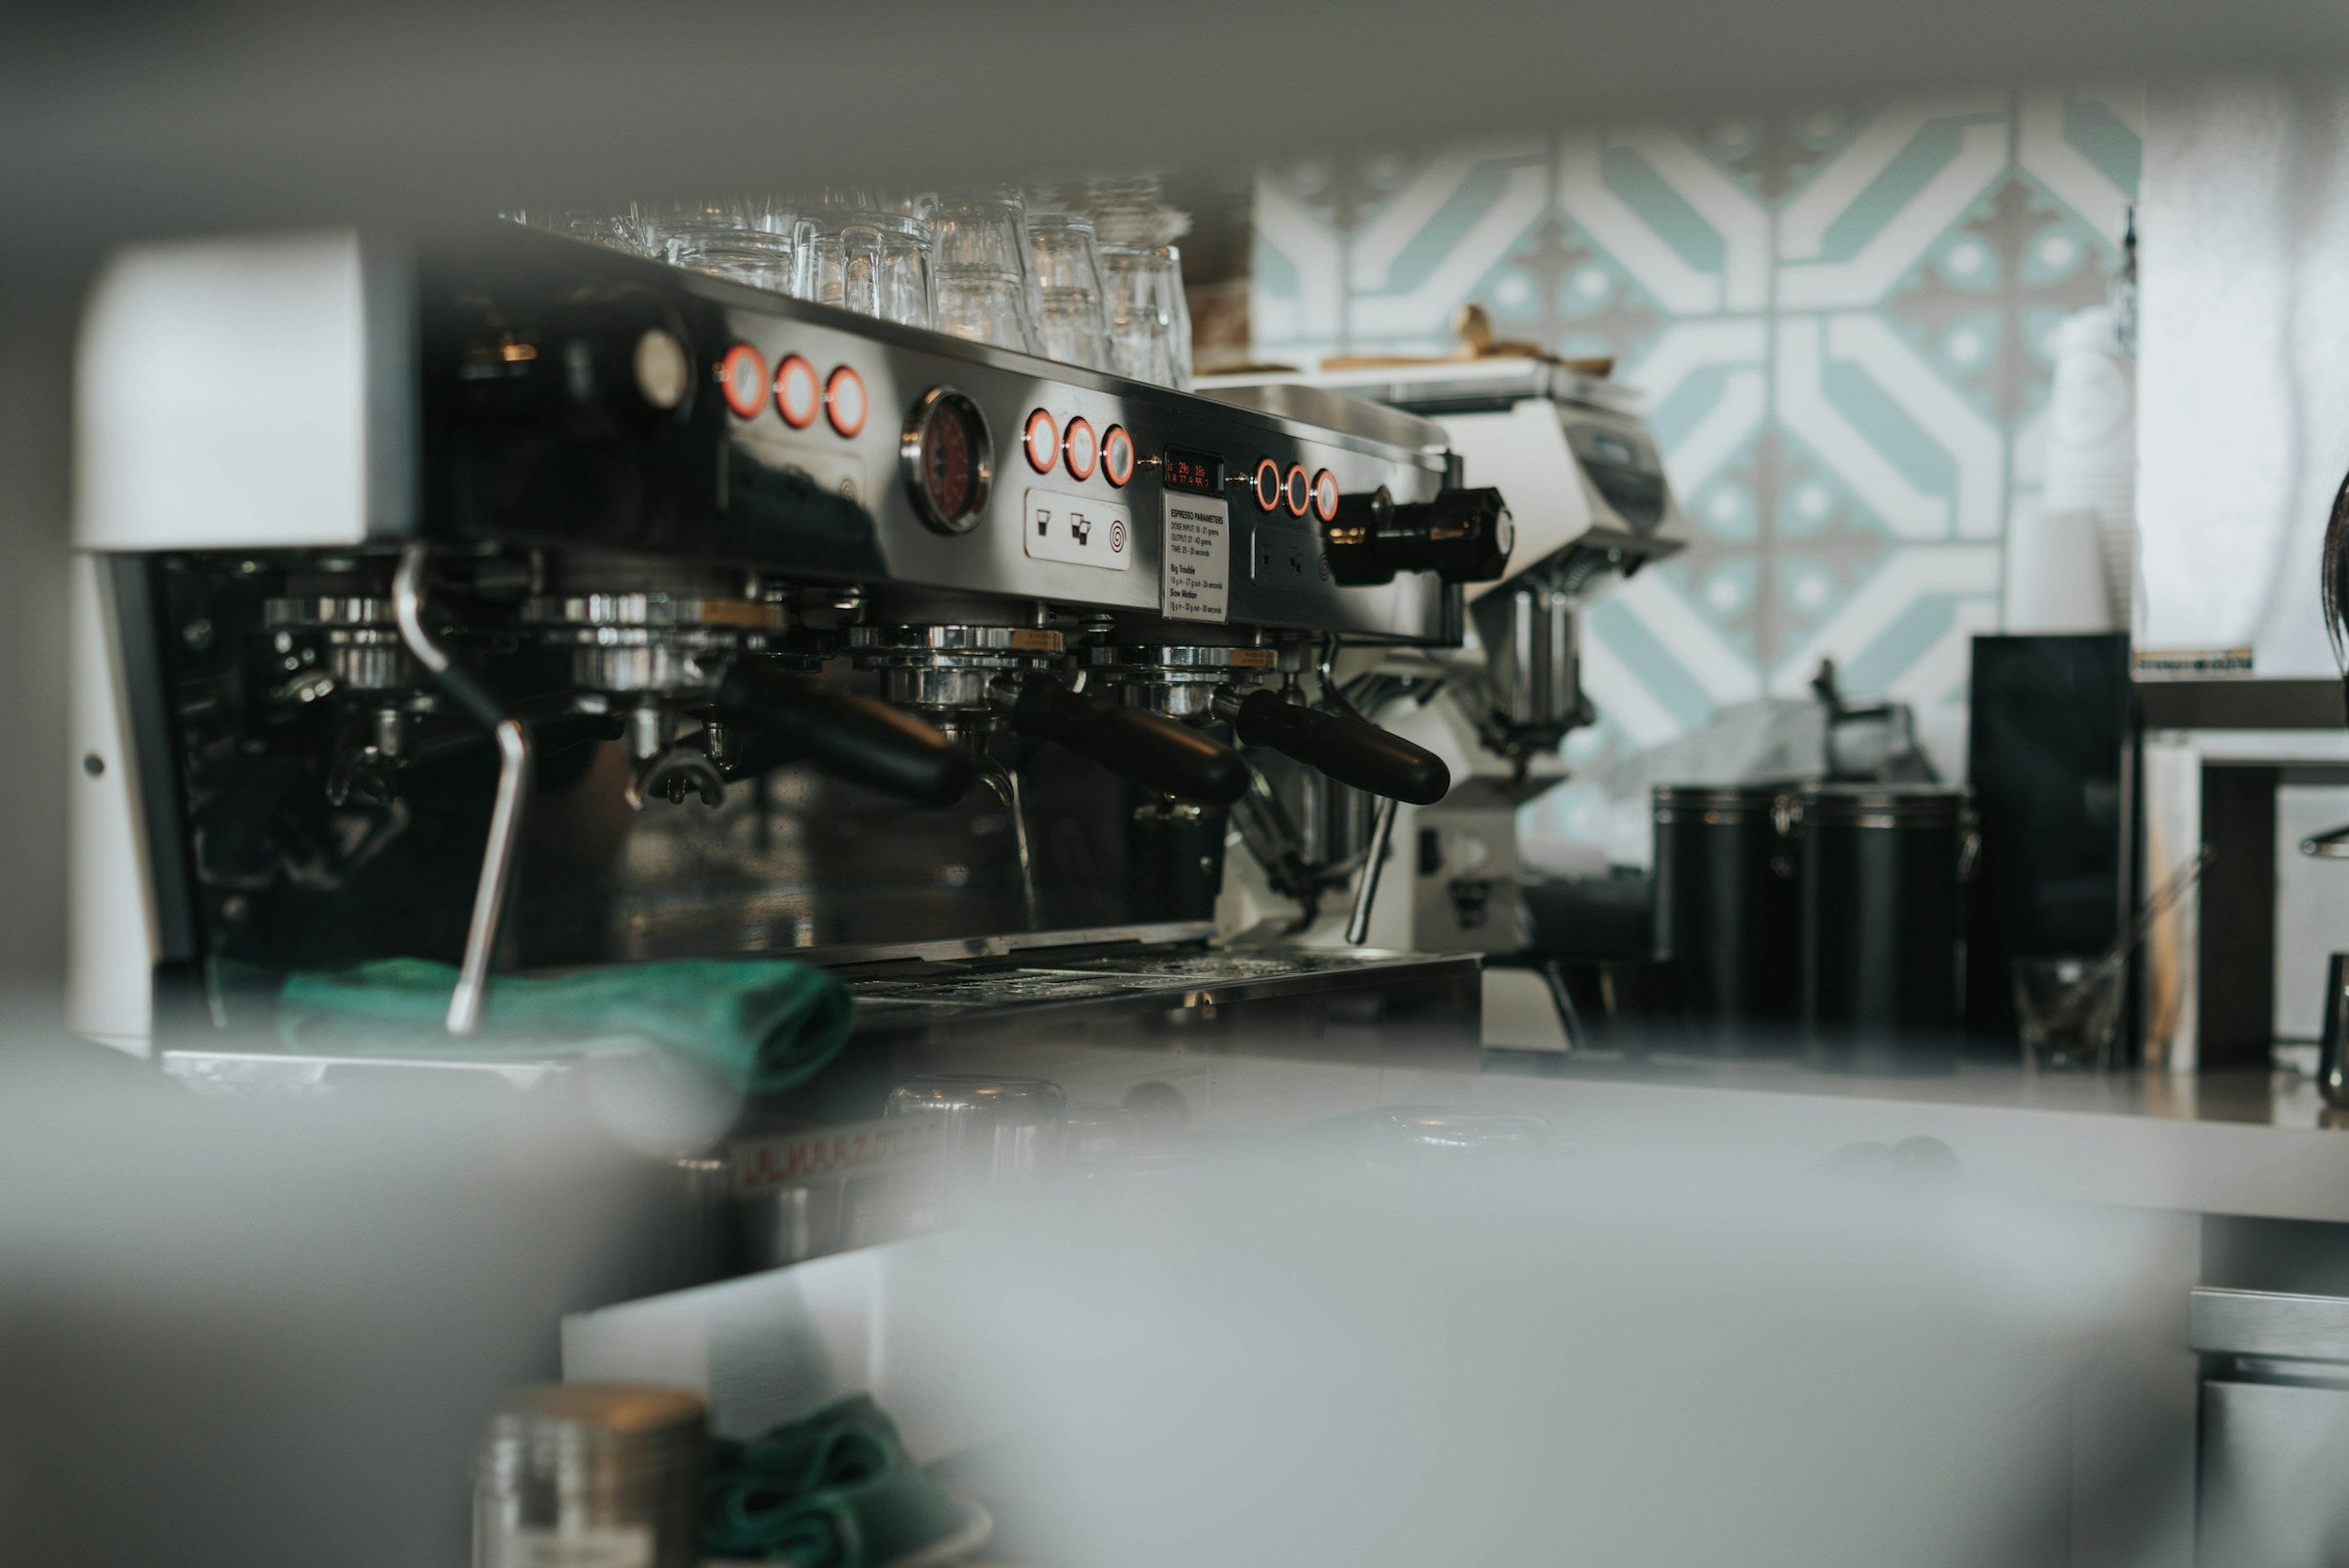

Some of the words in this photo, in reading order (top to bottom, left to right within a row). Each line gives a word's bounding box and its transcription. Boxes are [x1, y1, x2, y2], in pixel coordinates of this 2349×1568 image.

[1171, 509, 1193, 520] ESPRESSO
[1195, 513, 1223, 525] PARAMETERS
[1171, 522, 1182, 531] DOSE
[1179, 565, 1195, 575] Trouble
[1170, 588, 1180, 597] Slow
[1182, 590, 1197, 599] Motion
